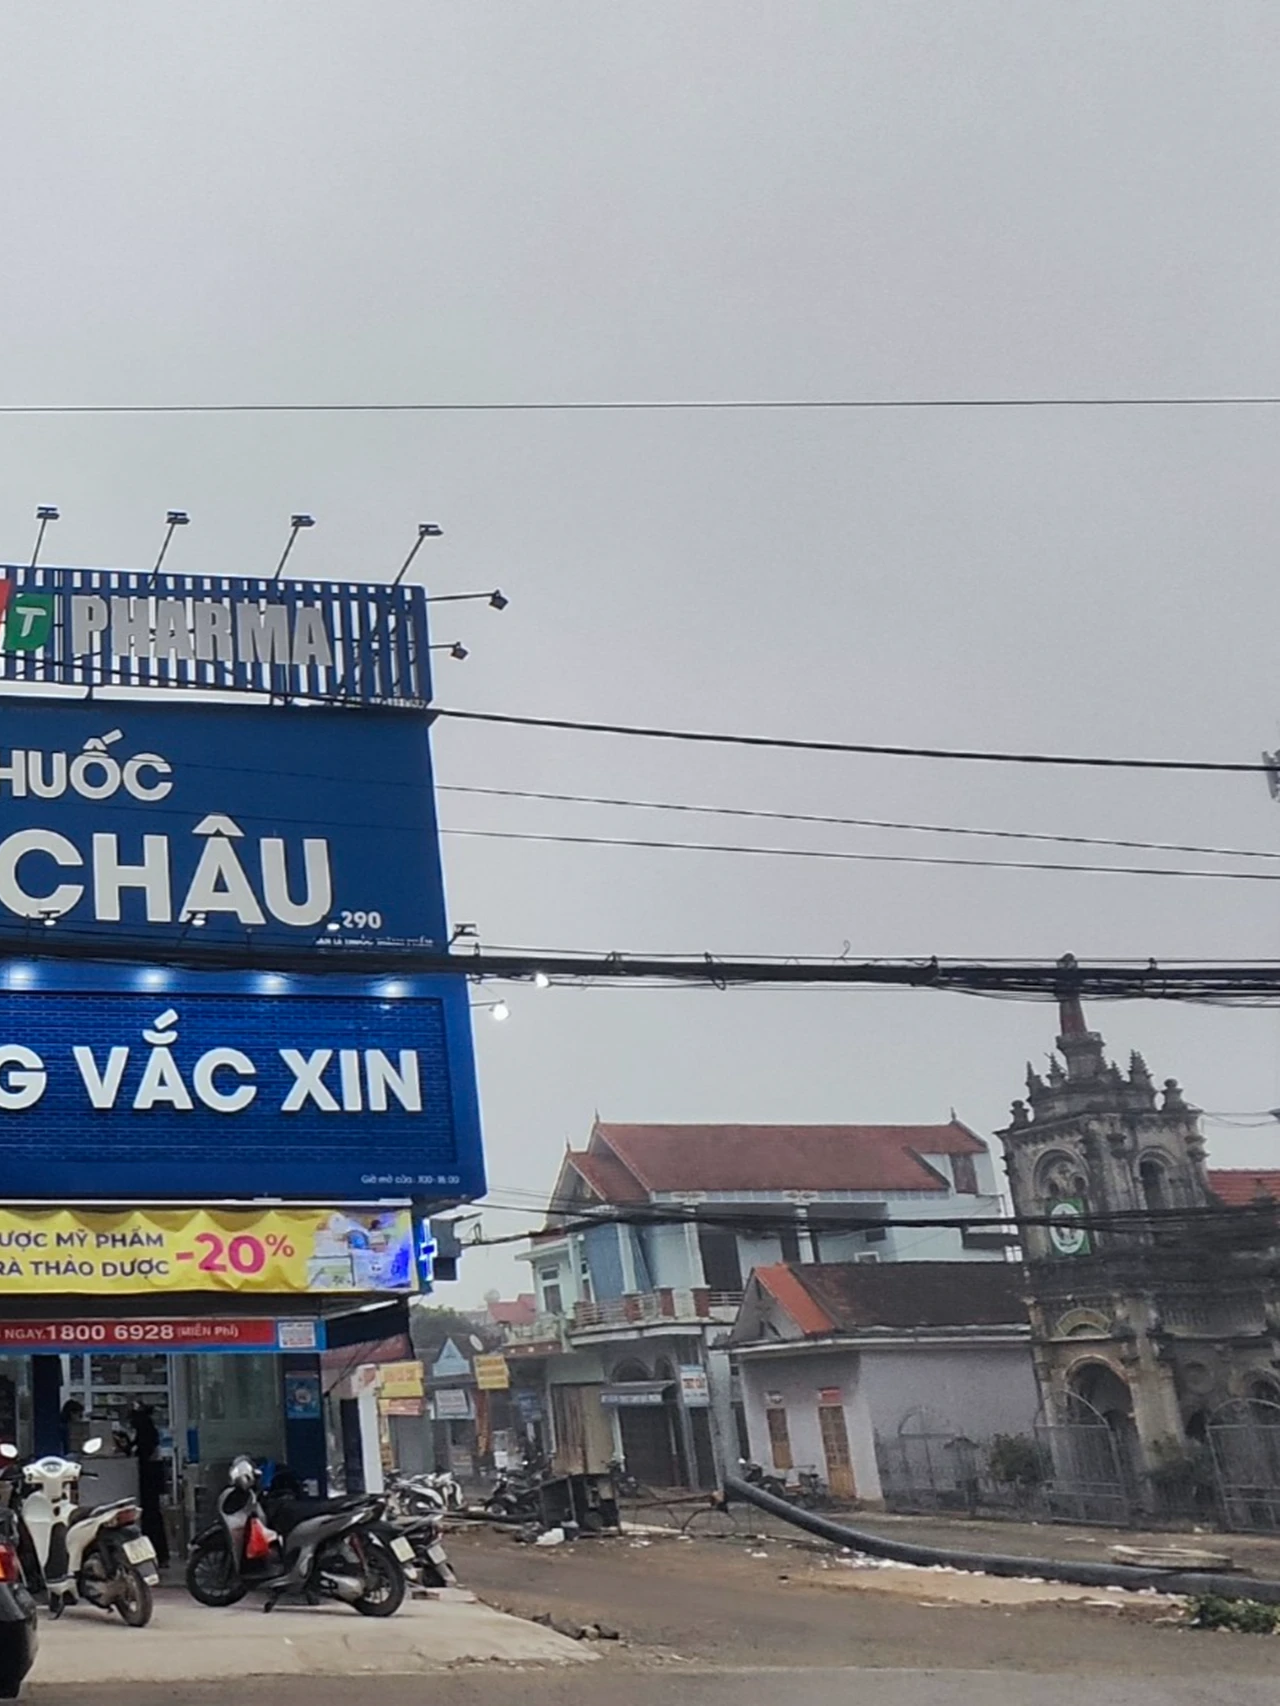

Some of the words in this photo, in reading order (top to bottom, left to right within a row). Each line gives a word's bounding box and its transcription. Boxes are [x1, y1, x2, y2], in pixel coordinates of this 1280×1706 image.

[70, 594, 333, 667] PHARMA
[341, 910, 382, 929] 290
[72, 1007, 258, 1113] VẮC
[278, 1048, 423, 1112] XIN
[56, 1227, 88, 1248] MỸ
[95, 1225, 164, 1249] PHẨM
[29, 1253, 94, 1277] THẢO
[101, 1257, 170, 1280] DƯỢC
[176, 1232, 296, 1276] -20%
[46, 1324, 106, 1341] 1800
[113, 1324, 175, 1341] 6928
